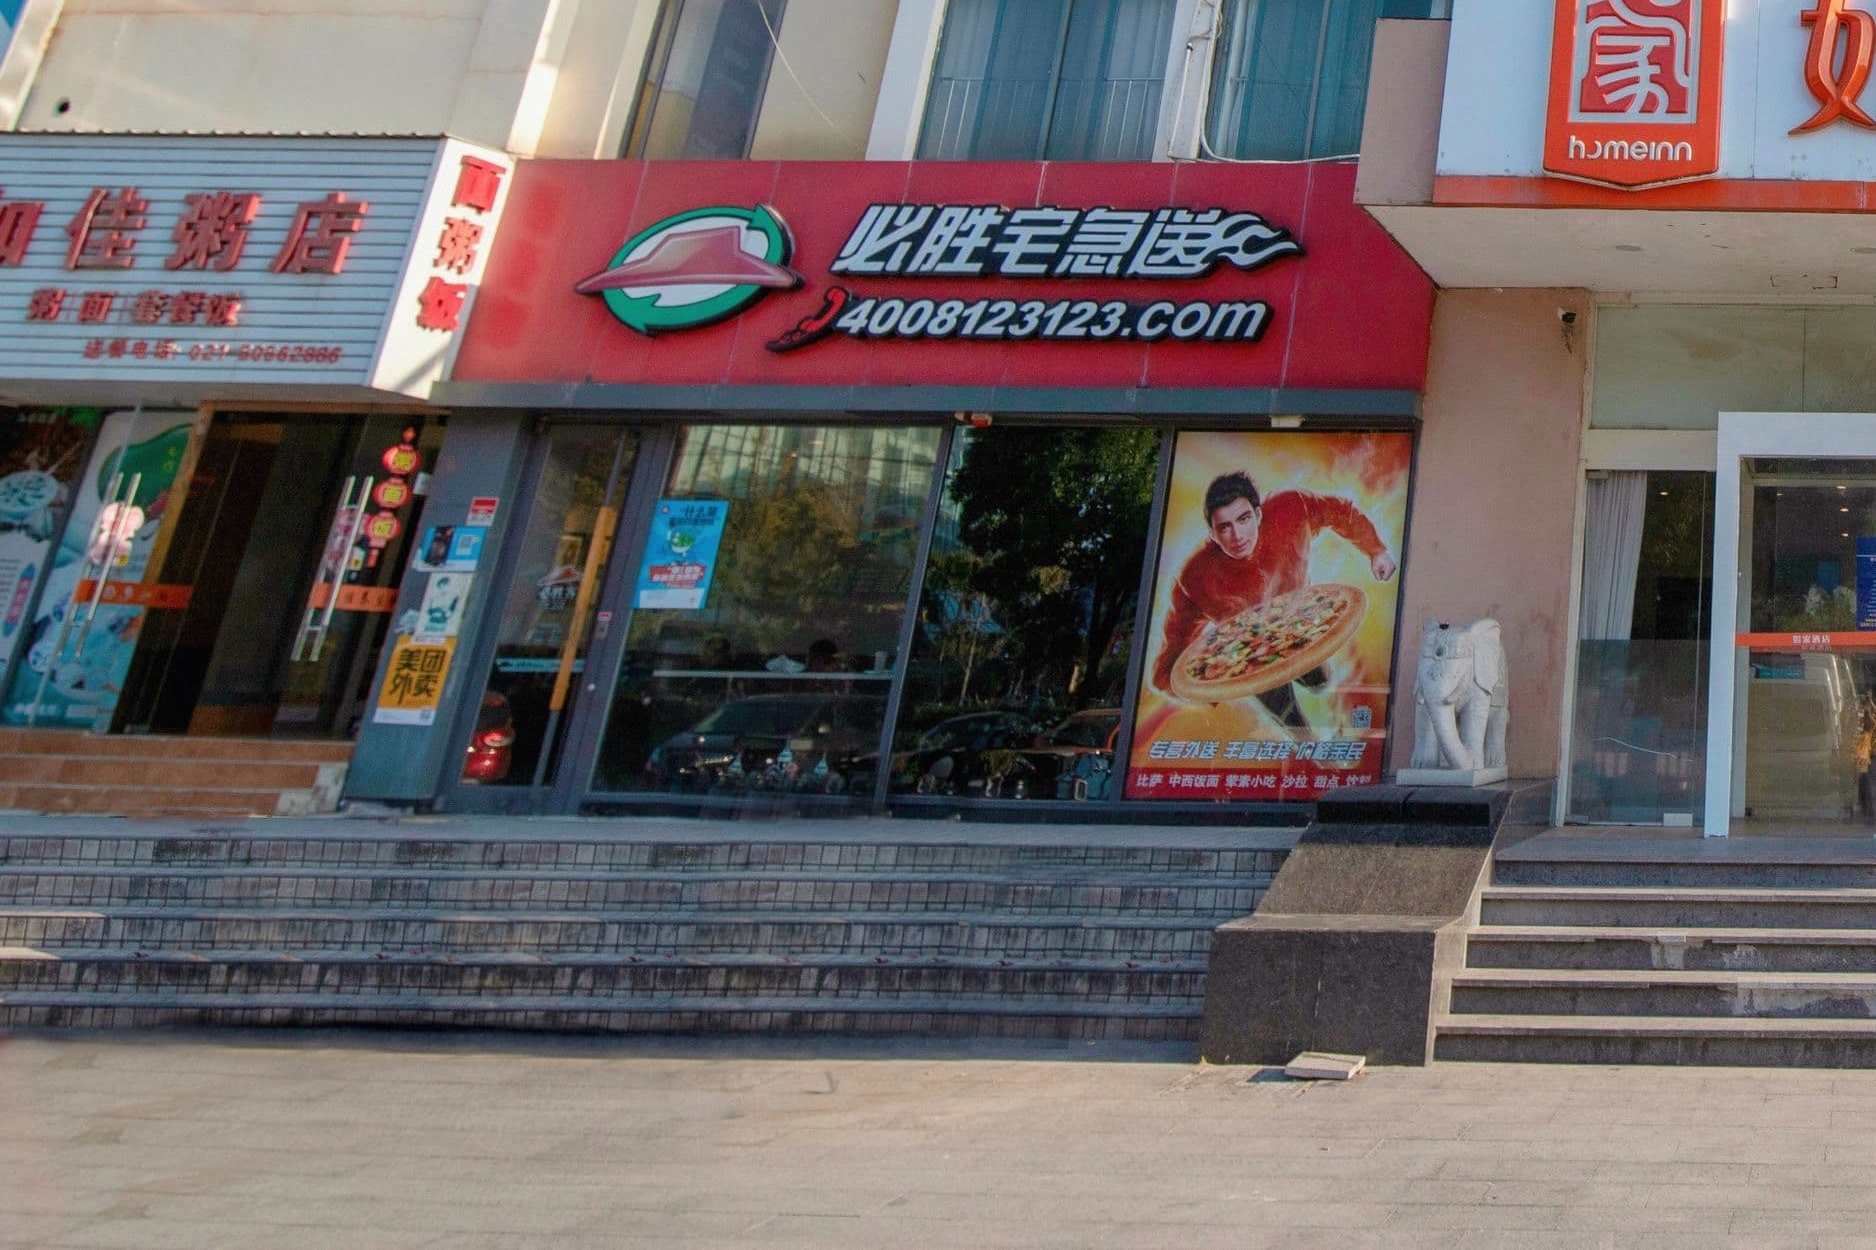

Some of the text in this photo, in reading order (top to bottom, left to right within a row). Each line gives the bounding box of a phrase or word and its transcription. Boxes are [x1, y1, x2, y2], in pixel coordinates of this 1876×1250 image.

[832, 204, 1232, 274] 必胜宅急送
[836, 297, 1268, 339] 4008123123.com
[396, 649, 447, 672] 美团
[1136, 774, 1163, 787] 比萨
[1281, 774, 1308, 788] 沙拉
[1314, 775, 1340, 788] 甜点
